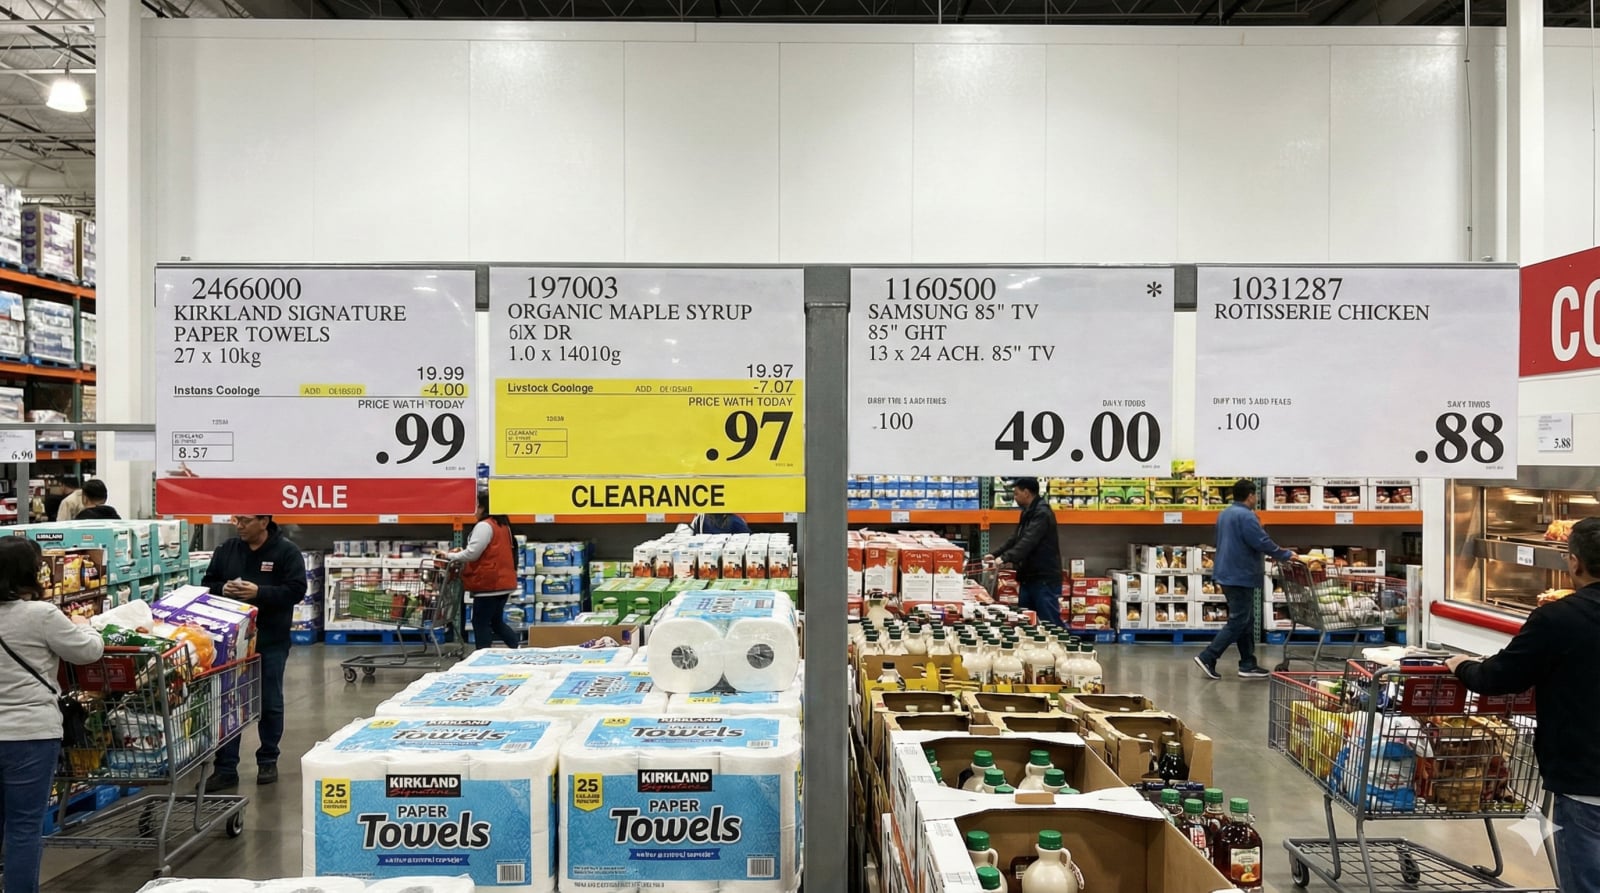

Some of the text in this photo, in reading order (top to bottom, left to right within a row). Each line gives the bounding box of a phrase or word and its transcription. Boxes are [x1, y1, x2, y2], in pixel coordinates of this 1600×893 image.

[192, 278, 301, 300] 2466000
[528, 276, 617, 299] 197003
[887, 278, 996, 300] 1160500
[1233, 277, 1342, 300] 1031287
[175, 305, 406, 321] KIRKLAND SIGNATURE
[508, 304, 752, 320] ORGANIC MAPLE SYRUP
[869, 304, 1038, 319] SAMSUNG 85" TV
[1215, 304, 1429, 320] ROTISSERIE CHICKEN
[175, 327, 329, 342] PAPER TOWELS
[544, 325, 571, 340] DR
[869, 324, 946, 340] 85" GHT
[175, 348, 261, 368] 27 x 10kg
[511, 346, 621, 365] 1.0 x 14010g
[870, 345, 1055, 361] 13 x 24 ACH. 85" TV
[418, 367, 464, 380] 19.99
[747, 364, 793, 378] 19.97
[424, 383, 465, 396] -4.00
[508, 383, 548, 393] Livstock
[753, 381, 793, 393] -7.07
[358, 400, 465, 409] PRICE WATH TODAY
[688, 397, 792, 406] PRICE WATH TODAY
[1217, 412, 1260, 431] .100
[376, 413, 465, 464] .99
[706, 410, 794, 461] .97
[995, 411, 1160, 462] 49.00
[1415, 412, 1504, 463] .88
[1554, 437, 1571, 448] 5.88
[179, 447, 208, 459] 8.57
[512, 443, 541, 455] 7.97
[282, 485, 347, 508] SALE
[571, 484, 725, 507] CLEARANCE
[392, 730, 508, 740] Towels
[632, 726, 742, 737] Towels
[390, 777, 458, 788] KIRKLAND
[641, 772, 710, 783] KIRKLAND
[325, 784, 346, 797] 25
[577, 779, 598, 792] 25
[398, 806, 447, 817] PAPER
[650, 800, 699, 812] PAPER
[359, 812, 489, 847] Towels
[612, 806, 741, 841] Towels
